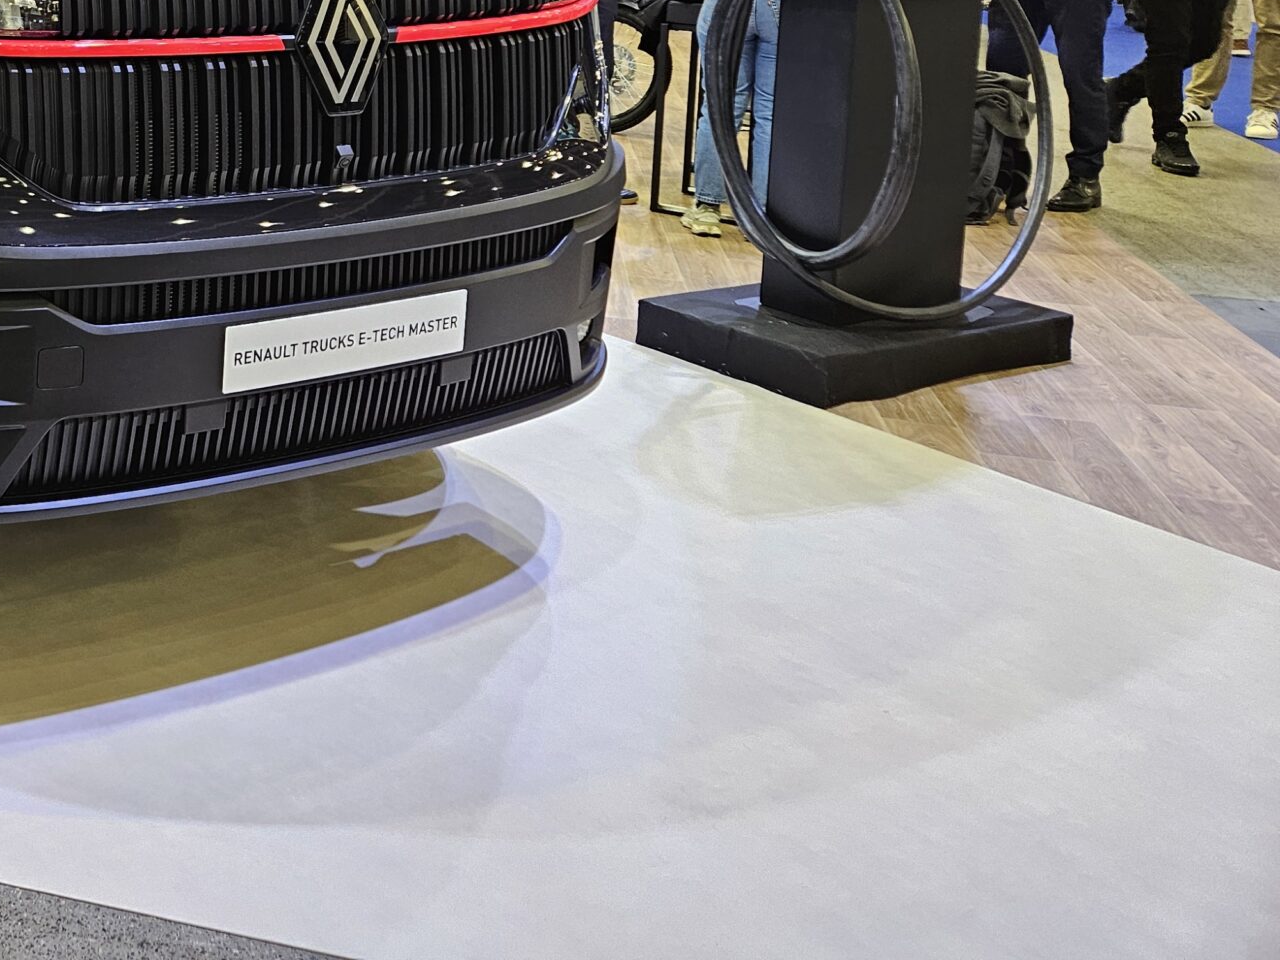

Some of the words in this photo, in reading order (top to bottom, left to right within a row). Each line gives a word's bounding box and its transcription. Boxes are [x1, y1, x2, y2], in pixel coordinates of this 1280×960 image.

[234, 343, 299, 366] RENAULT
[302, 334, 354, 355] TRUCKS
[358, 324, 405, 346] E-TECH
[408, 315, 458, 336] MASTER
